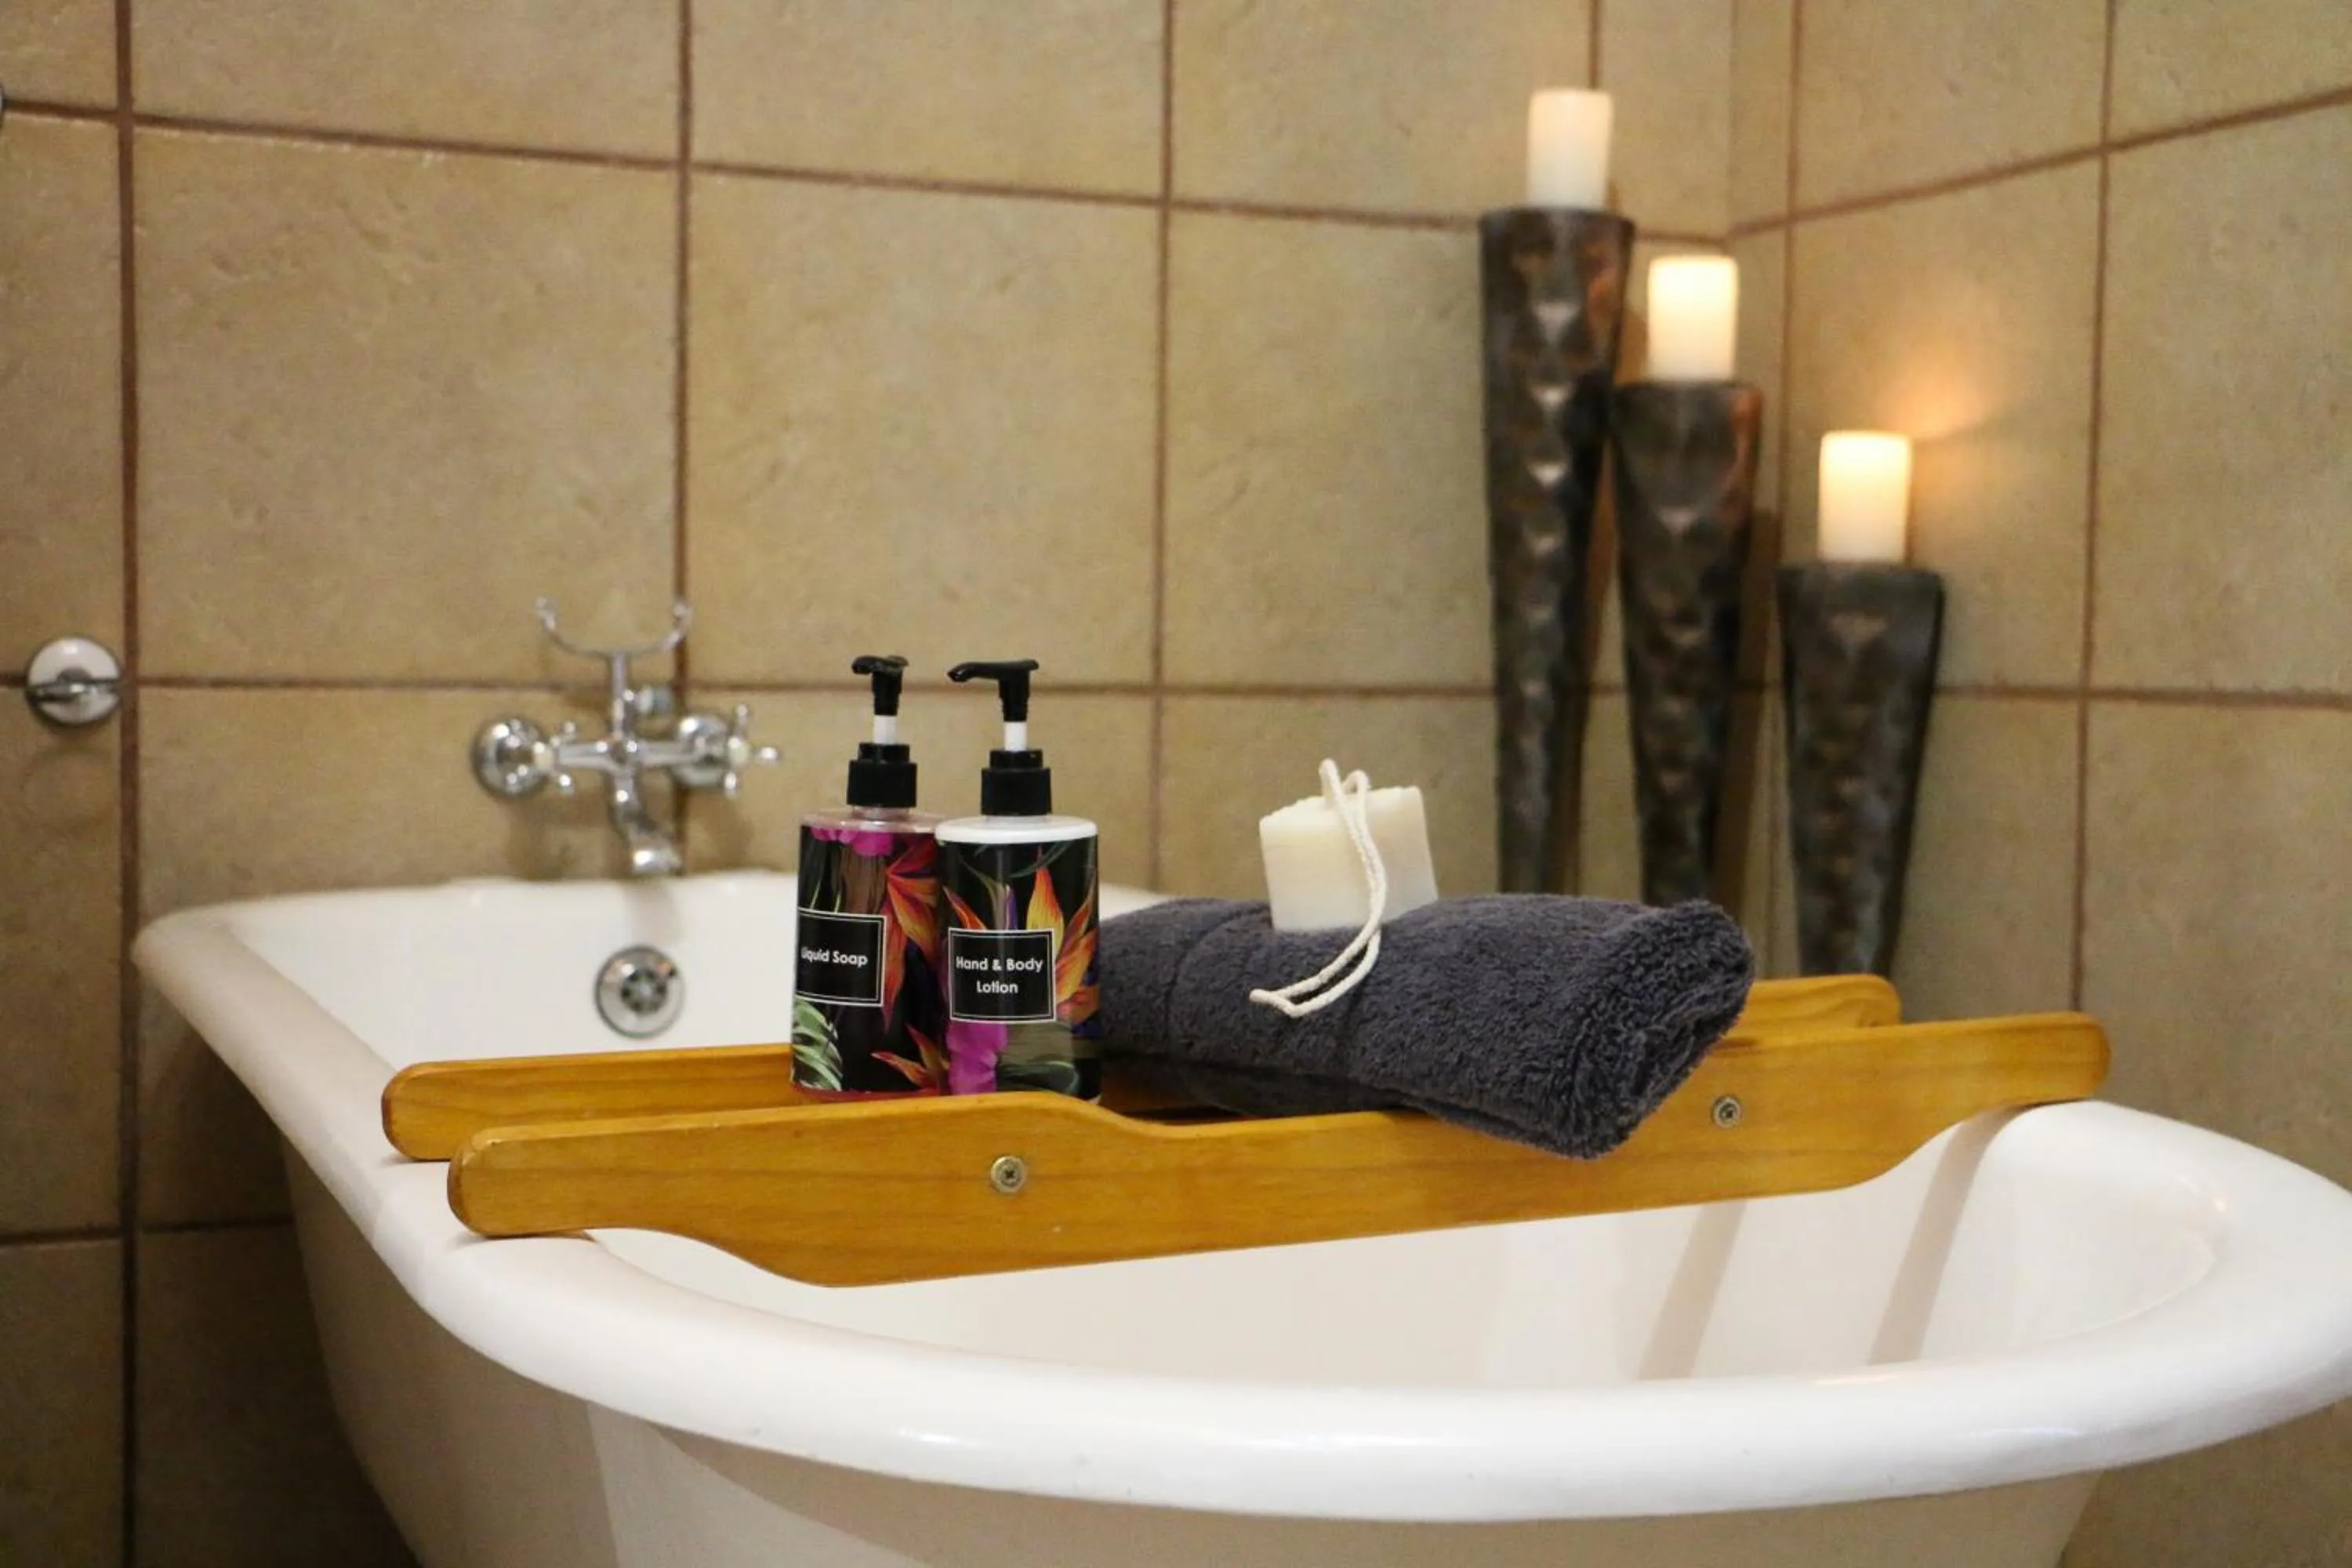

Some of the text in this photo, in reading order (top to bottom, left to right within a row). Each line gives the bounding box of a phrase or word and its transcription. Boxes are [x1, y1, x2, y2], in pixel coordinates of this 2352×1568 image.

[833, 950, 868, 967] Soap
[956, 956, 1044, 973] Hand & Body
[976, 980, 1018, 994] Lotion
